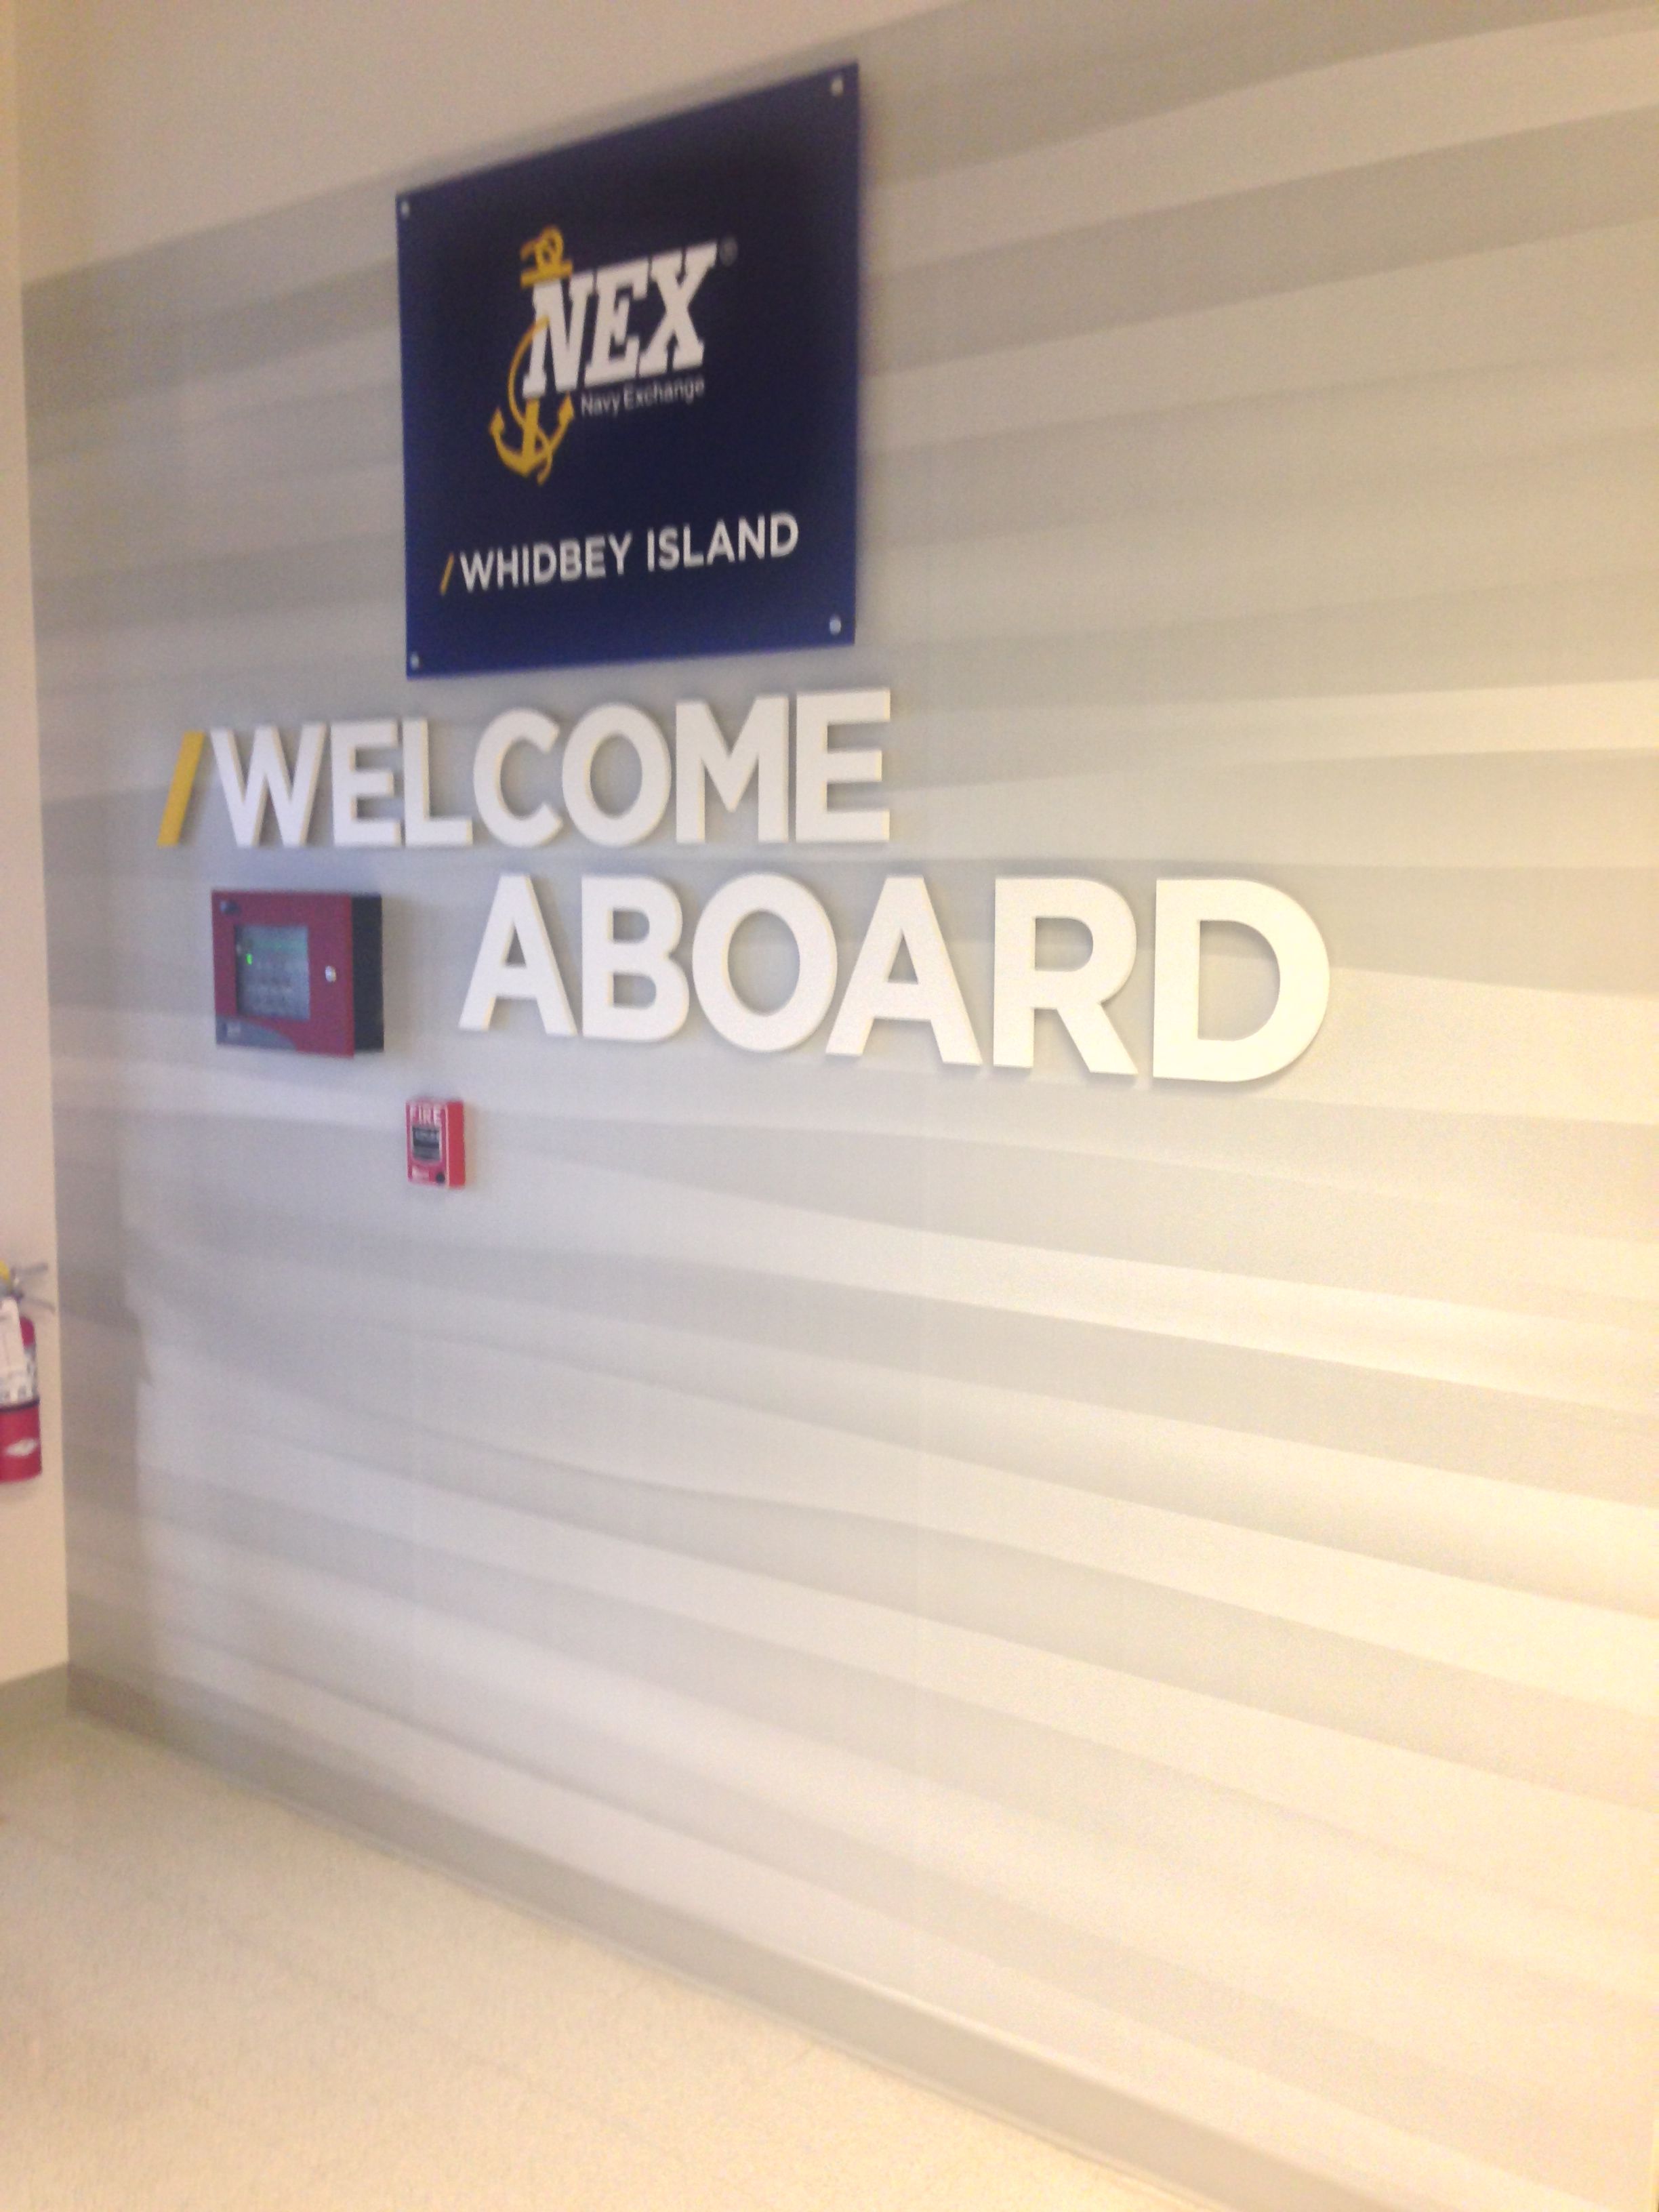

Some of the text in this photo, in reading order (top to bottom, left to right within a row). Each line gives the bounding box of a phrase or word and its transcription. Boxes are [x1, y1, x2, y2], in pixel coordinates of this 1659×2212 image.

[581, 375, 705, 416] Navy Exchange
[646, 511, 800, 572] ISLAND
[459, 872, 1330, 1082] ABOARD
[409, 1105, 441, 1127] FIRE
